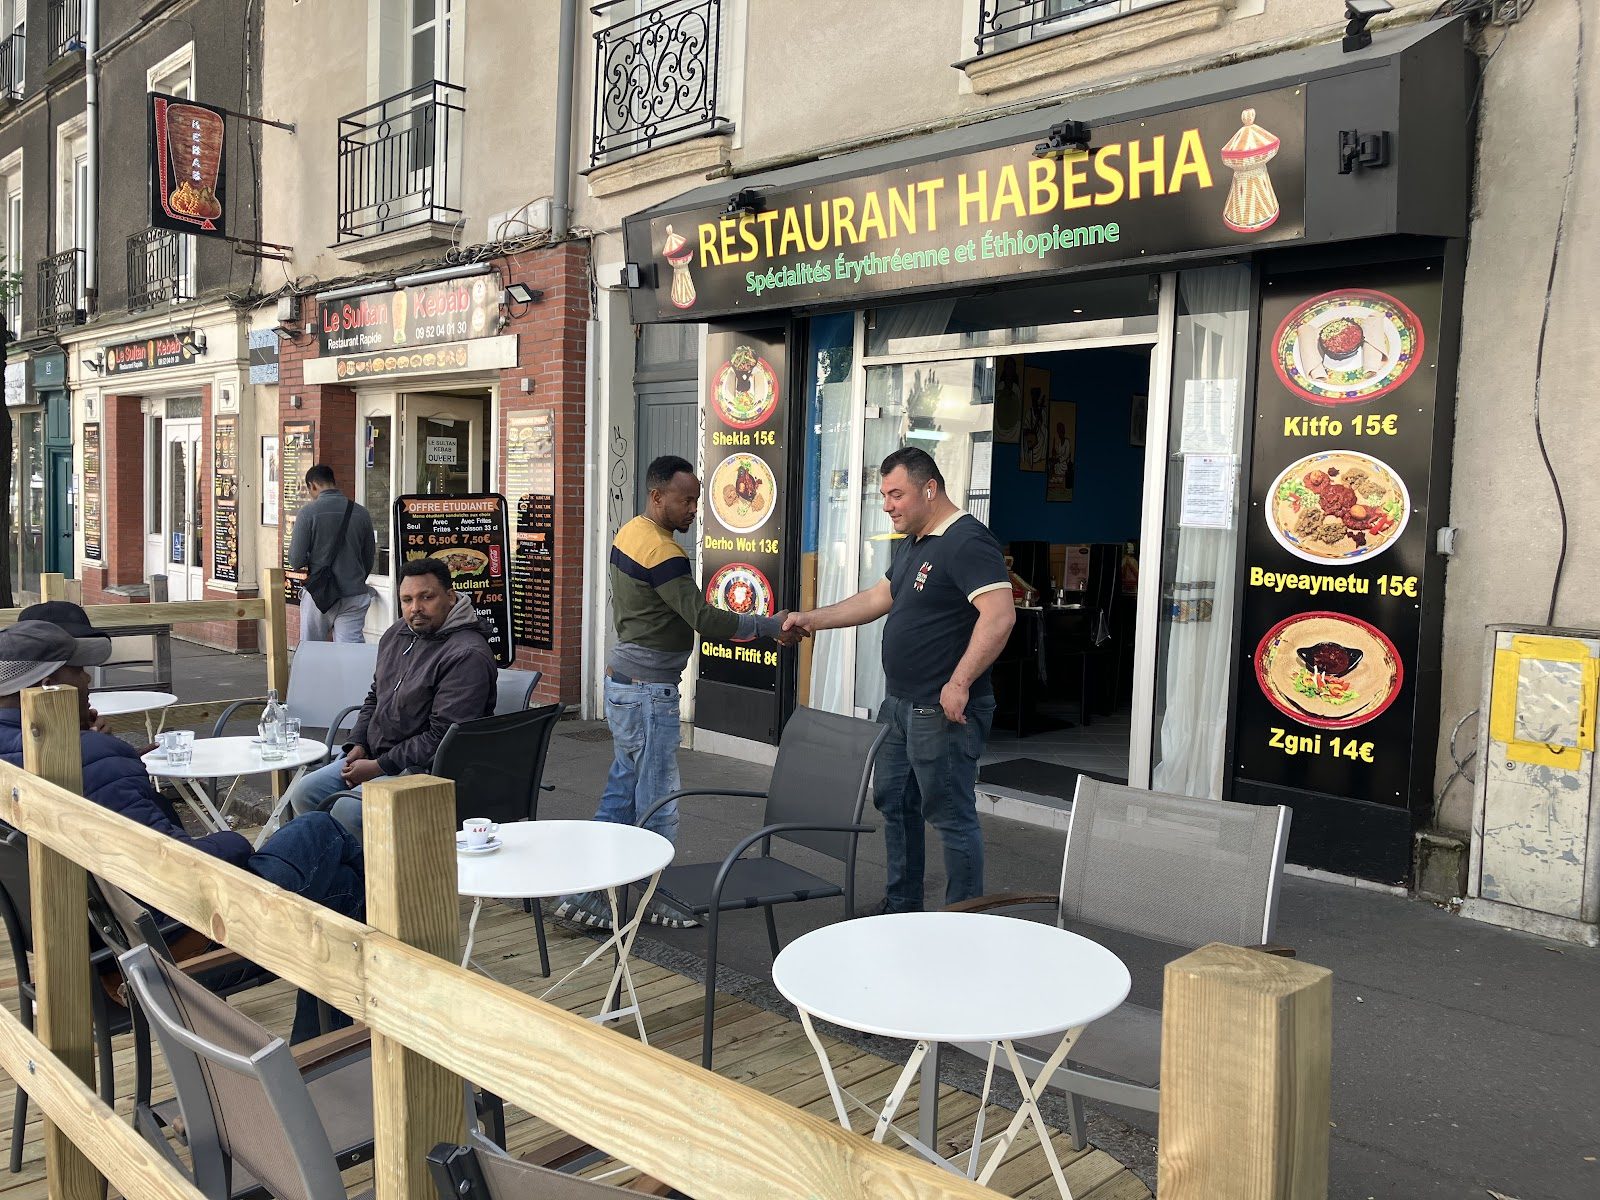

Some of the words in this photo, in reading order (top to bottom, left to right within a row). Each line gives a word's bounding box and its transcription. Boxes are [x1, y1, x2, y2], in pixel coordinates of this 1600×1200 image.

[698, 178, 945, 268] RESTAURANT
[957, 128, 1214, 226] HABESHA
[746, 258, 831, 297] Spécialités
[834, 246, 950, 284] Érythréenne
[954, 239, 976, 261] et
[981, 221, 1120, 259] Éthiopienne
[413, 285, 471, 319] Kebab
[323, 308, 340, 333] Le
[342, 300, 388, 330] Sultan
[415, 326, 424, 340] 09
[425, 325, 435, 338] 52
[436, 323, 445, 337] 04
[457, 320, 467, 334] 30
[327, 334, 359, 350] Restaurant
[359, 332, 382, 347] Rapide
[1284, 415, 1342, 437] Kitfo
[1351, 413, 1398, 437] 15€
[753, 430, 776, 446] 15€
[408, 502, 441, 512] OFFRE
[442, 500, 494, 512] ÉTUDIANTE
[408, 534, 424, 545] 5€
[428, 533, 458, 546] 6,50€
[461, 533, 491, 546] 7,50€
[705, 535, 733, 551] Derho
[736, 537, 756, 553] Wot
[759, 539, 779, 554] 13€
[452, 579, 490, 590] tudiant
[1250, 566, 1369, 595] Beyeaynetu
[1376, 574, 1418, 597] 15€
[474, 590, 504, 605] 7,50€
[701, 641, 733, 659] Qicha
[735, 646, 761, 664] Fitfit
[764, 651, 777, 667] 8€
[1268, 727, 1321, 755] Zgni
[1329, 737, 1375, 763] 14€
